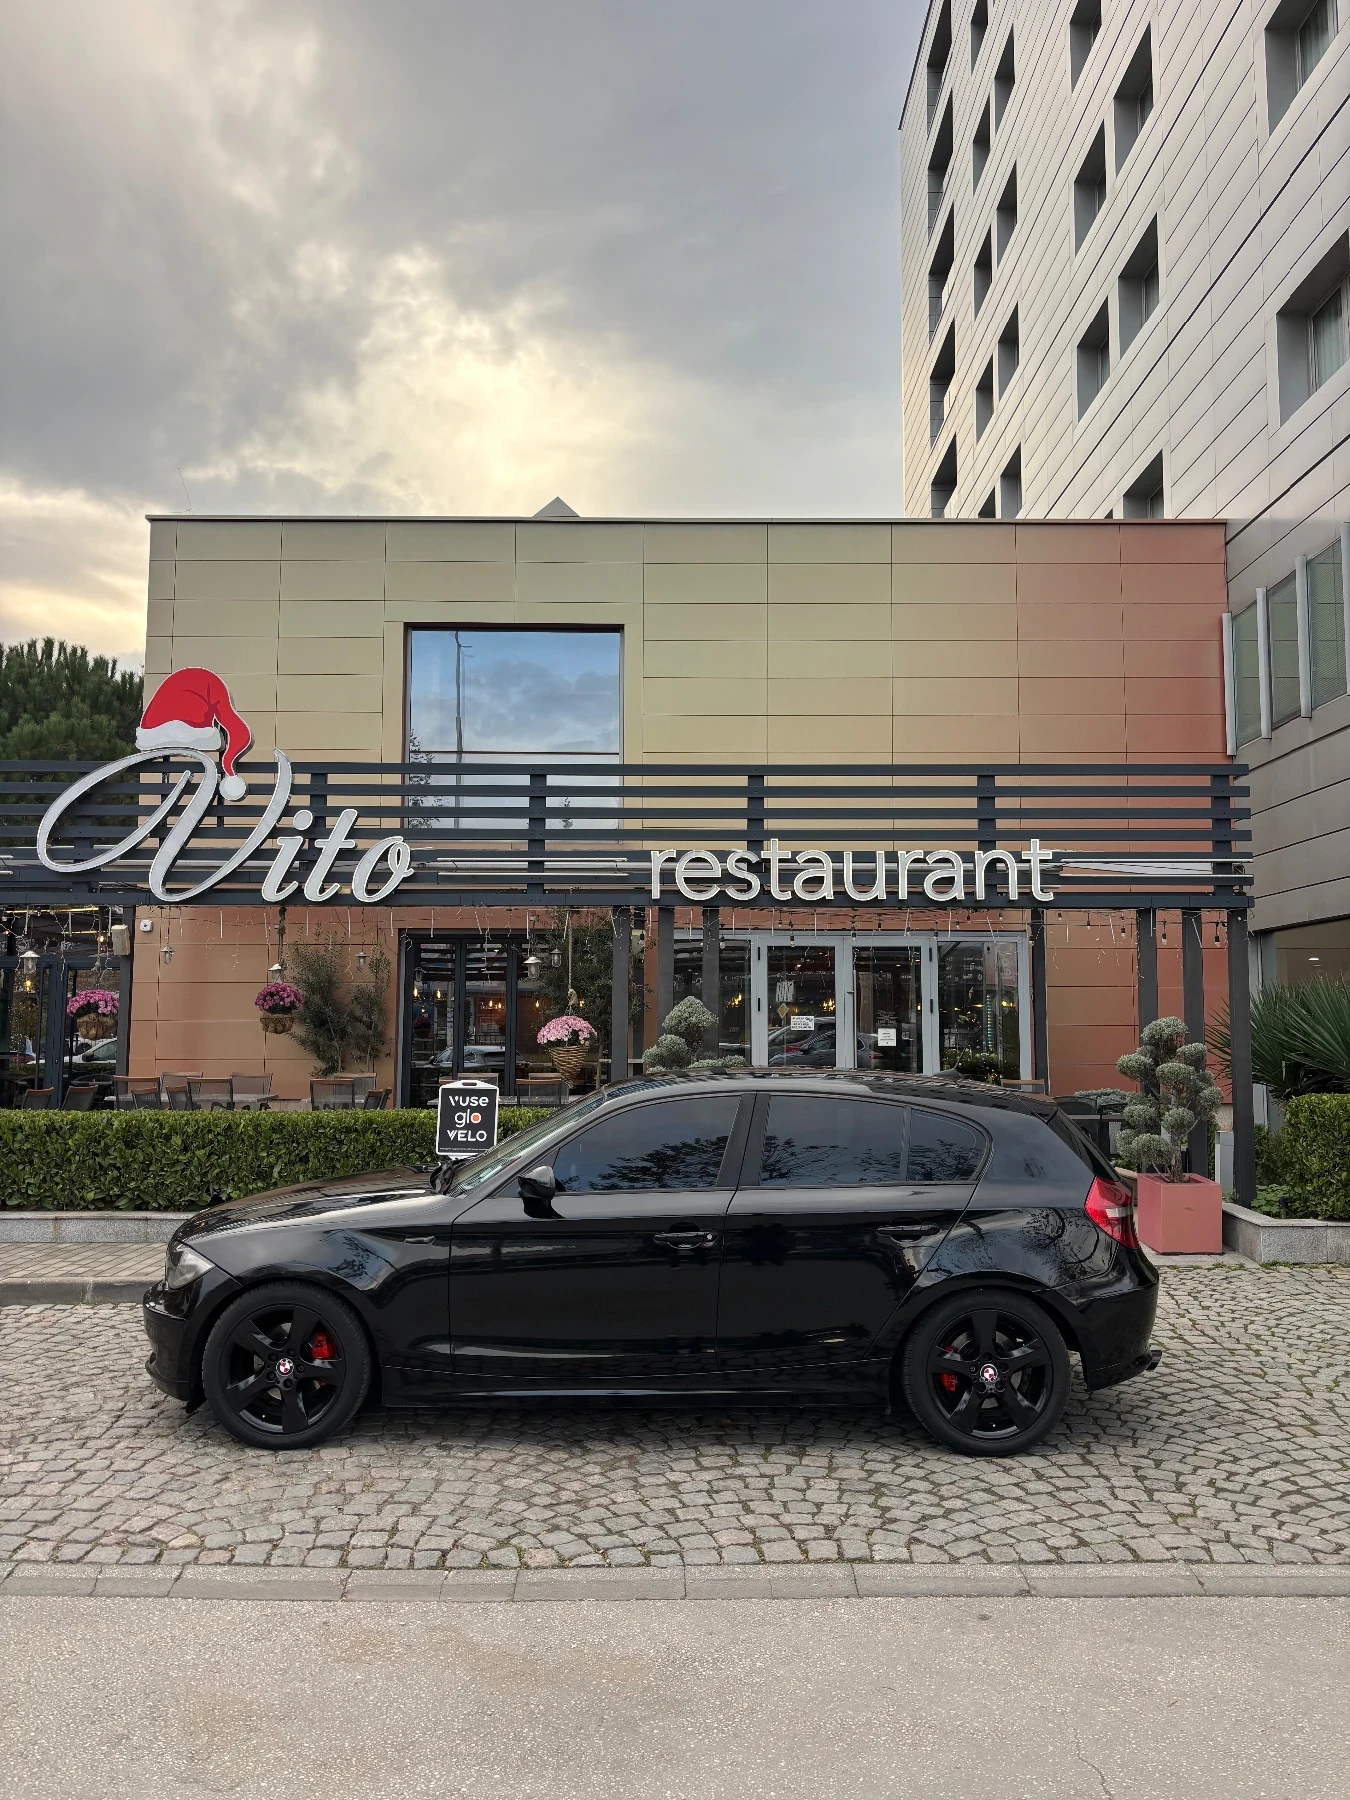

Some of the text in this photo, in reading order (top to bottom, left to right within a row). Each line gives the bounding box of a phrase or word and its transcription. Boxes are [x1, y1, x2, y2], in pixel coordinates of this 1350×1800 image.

[36, 747, 1056, 903] Vito restaurant
[448, 1095, 489, 1107] vuse
[454, 1109, 482, 1128] glo
[447, 1130, 487, 1141] VELO
